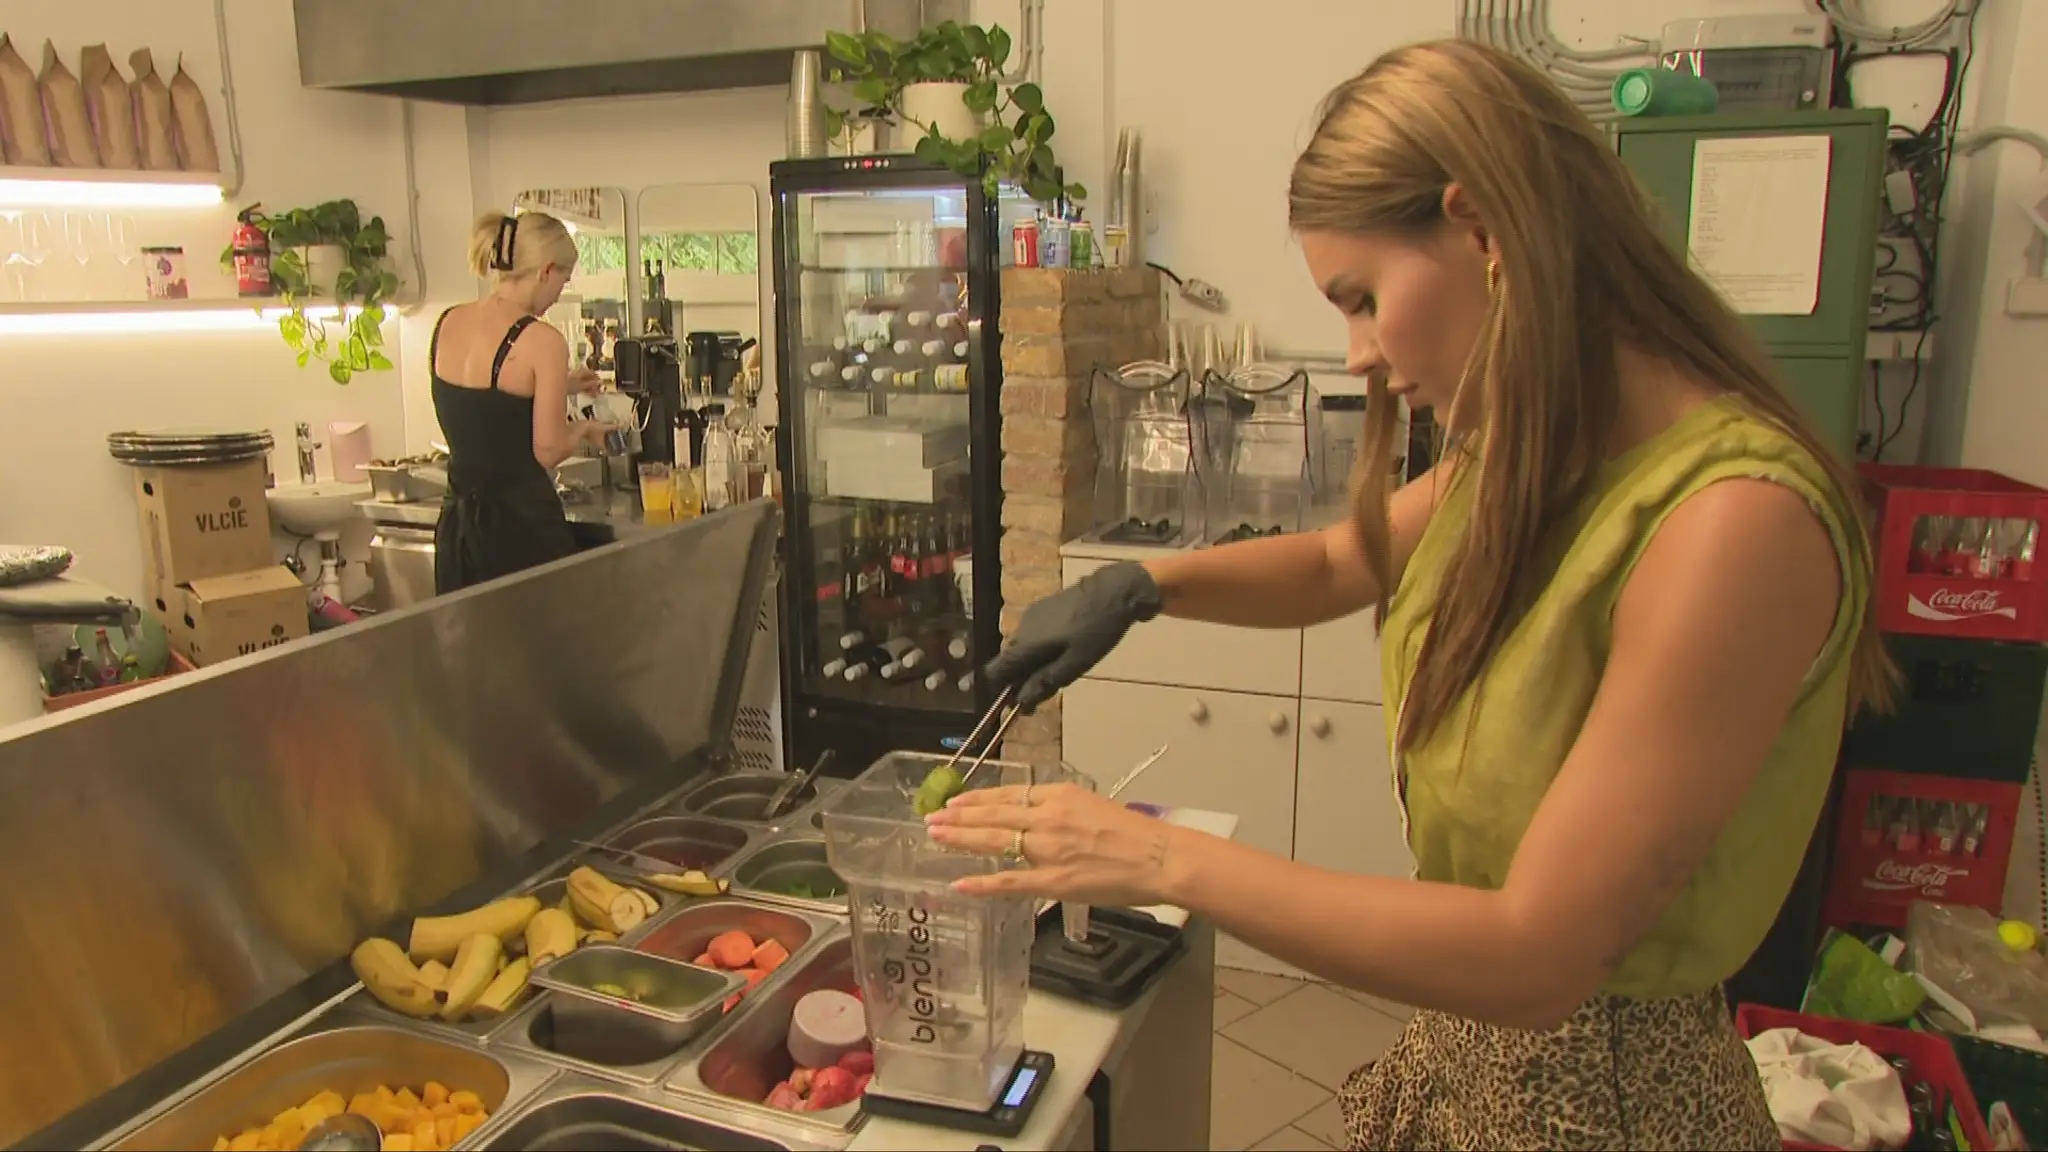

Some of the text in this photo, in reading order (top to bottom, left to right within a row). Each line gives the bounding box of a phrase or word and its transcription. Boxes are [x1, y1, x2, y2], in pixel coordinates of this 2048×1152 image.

[1928, 587, 2001, 612] Coca-Cola
[1875, 859, 1958, 887] Coca-Cola
[908, 905, 937, 1044] blendtec
